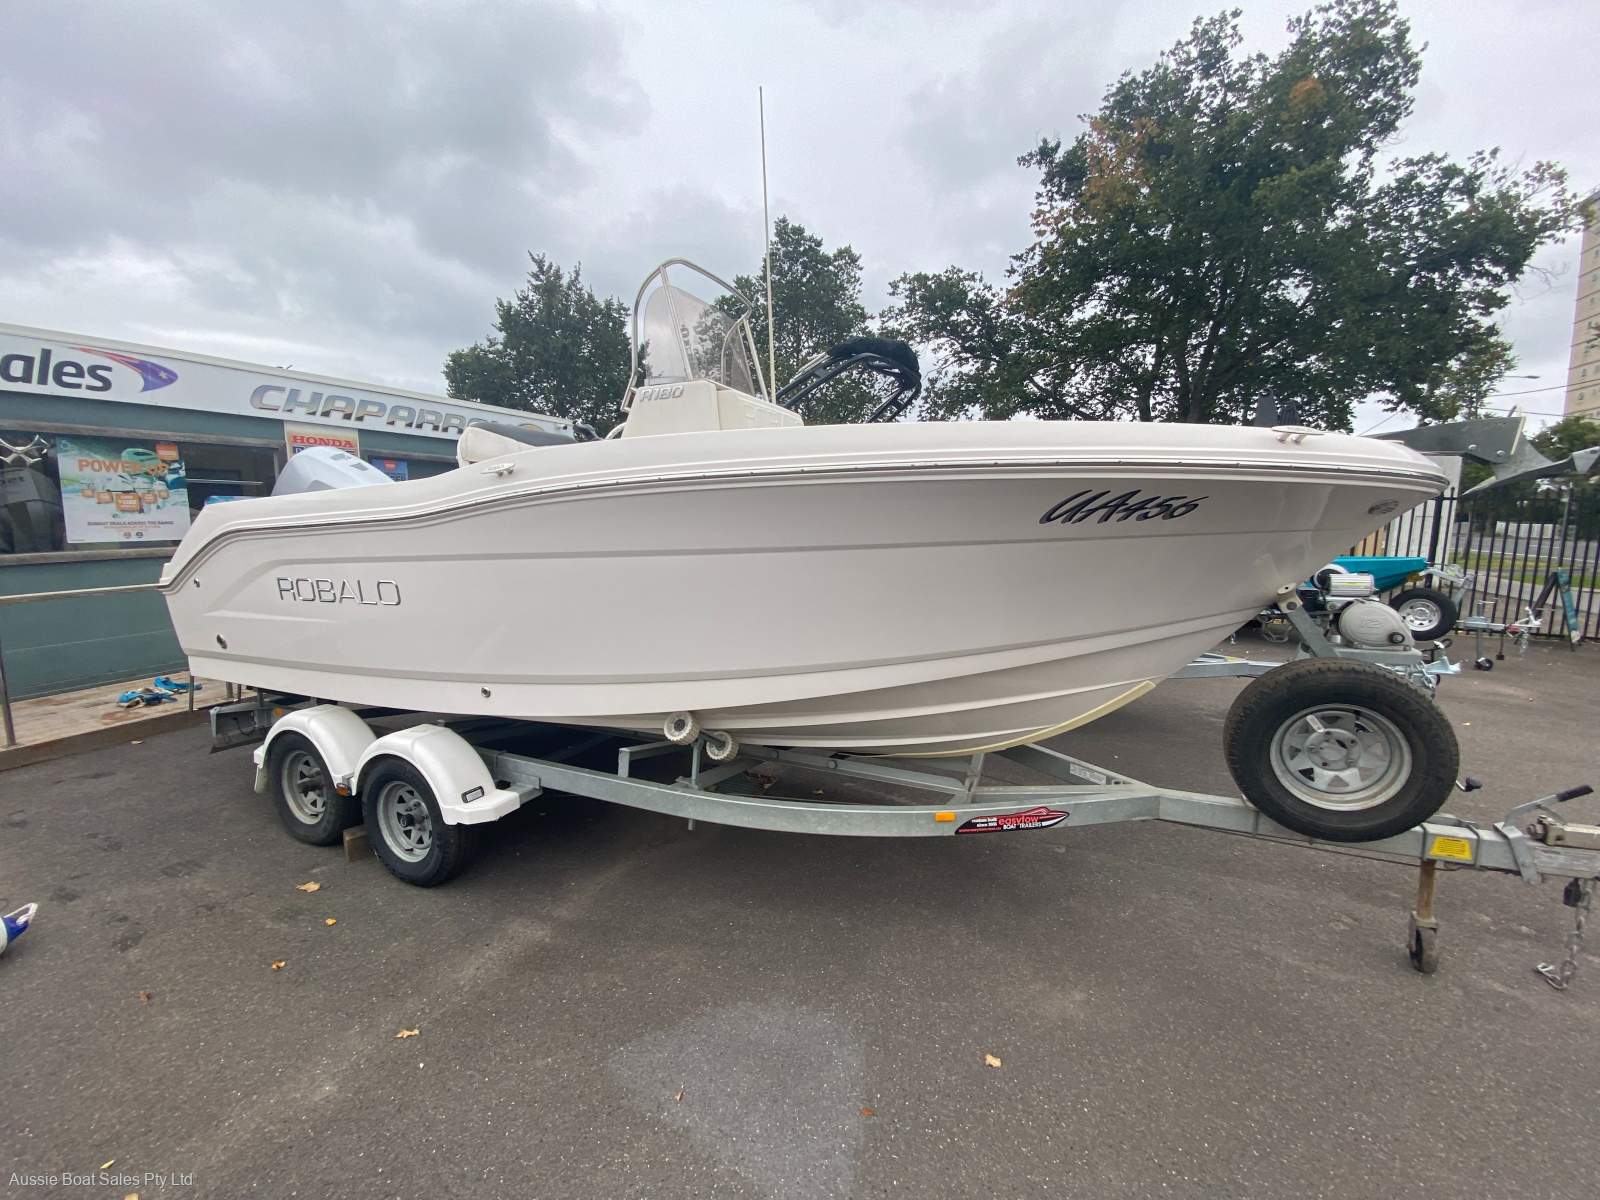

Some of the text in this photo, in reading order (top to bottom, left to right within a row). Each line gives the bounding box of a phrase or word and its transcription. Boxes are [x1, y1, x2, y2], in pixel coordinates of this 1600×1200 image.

[249, 385, 489, 434] CHAPARR
[292, 435, 356, 448] HONDA
[277, 577, 402, 606] ROBALO
